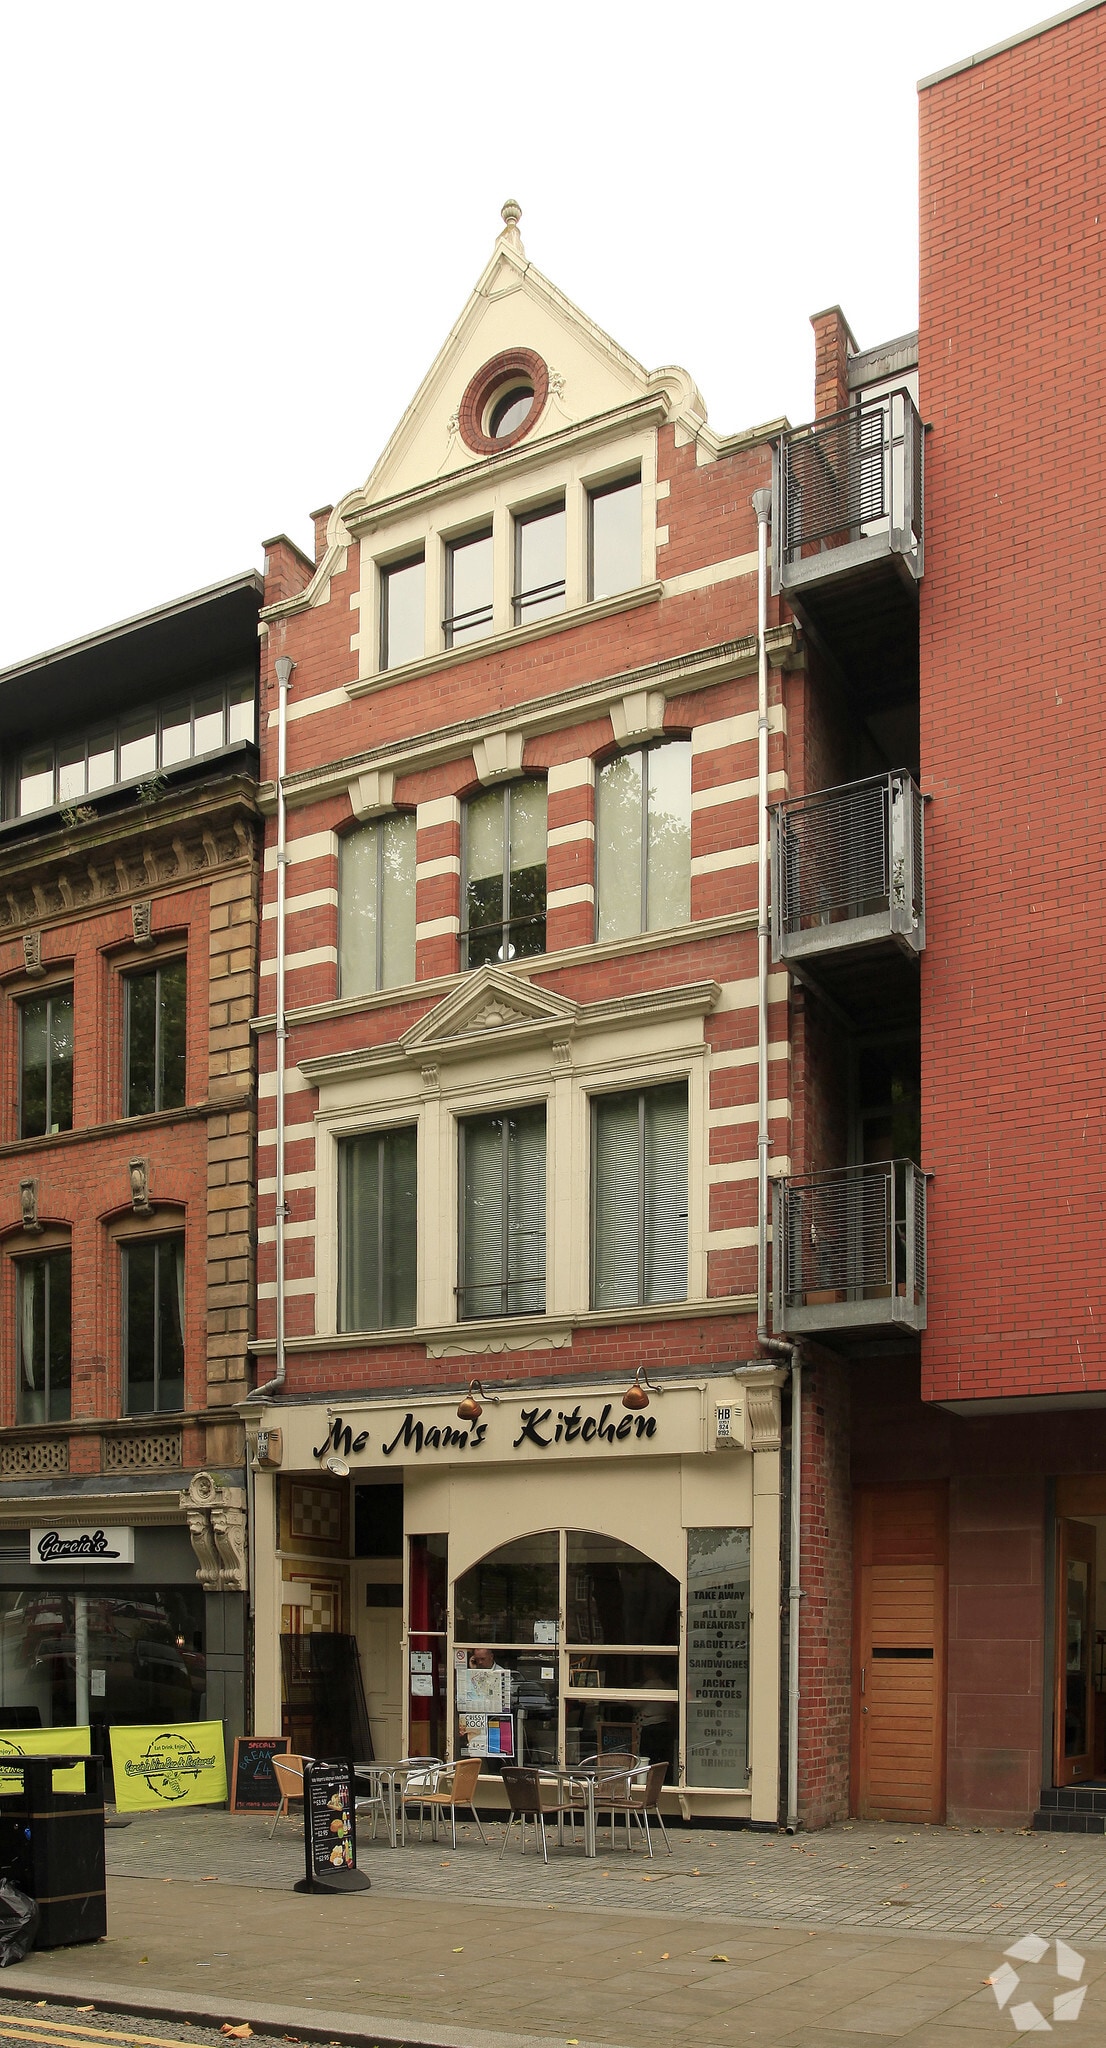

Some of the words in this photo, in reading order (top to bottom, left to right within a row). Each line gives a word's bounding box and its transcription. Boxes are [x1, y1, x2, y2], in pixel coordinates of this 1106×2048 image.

[718, 1409, 730, 1419] HB
[313, 1418, 369, 1457] Me
[382, 1414, 488, 1454] Mam's
[512, 1404, 657, 1448] Kitchen
[38, 1530, 108, 1561] Garcia's
[693, 1590, 716, 1600] TAKE
[718, 1591, 745, 1600] AWAY
[702, 1610, 718, 1619] ALL
[719, 1610, 737, 1619] DAY
[693, 1620, 746, 1630] BREAKFAST
[693, 1640, 747, 1650] BAGUETTES
[689, 1659, 748, 1669] SANDWICHES
[702, 1679, 736, 1688] JACKET
[695, 1689, 742, 1699] POTATOES
[697, 1709, 741, 1718] BURGERS
[465, 1720, 486, 1728] ROCK
[704, 1728, 733, 1737] CHIPS
[691, 1748, 710, 1757] HOT
[186, 1755, 215, 1767] Restaurant
[701, 1758, 736, 1768] DRINKS
[253, 1760, 272, 1776] £4
